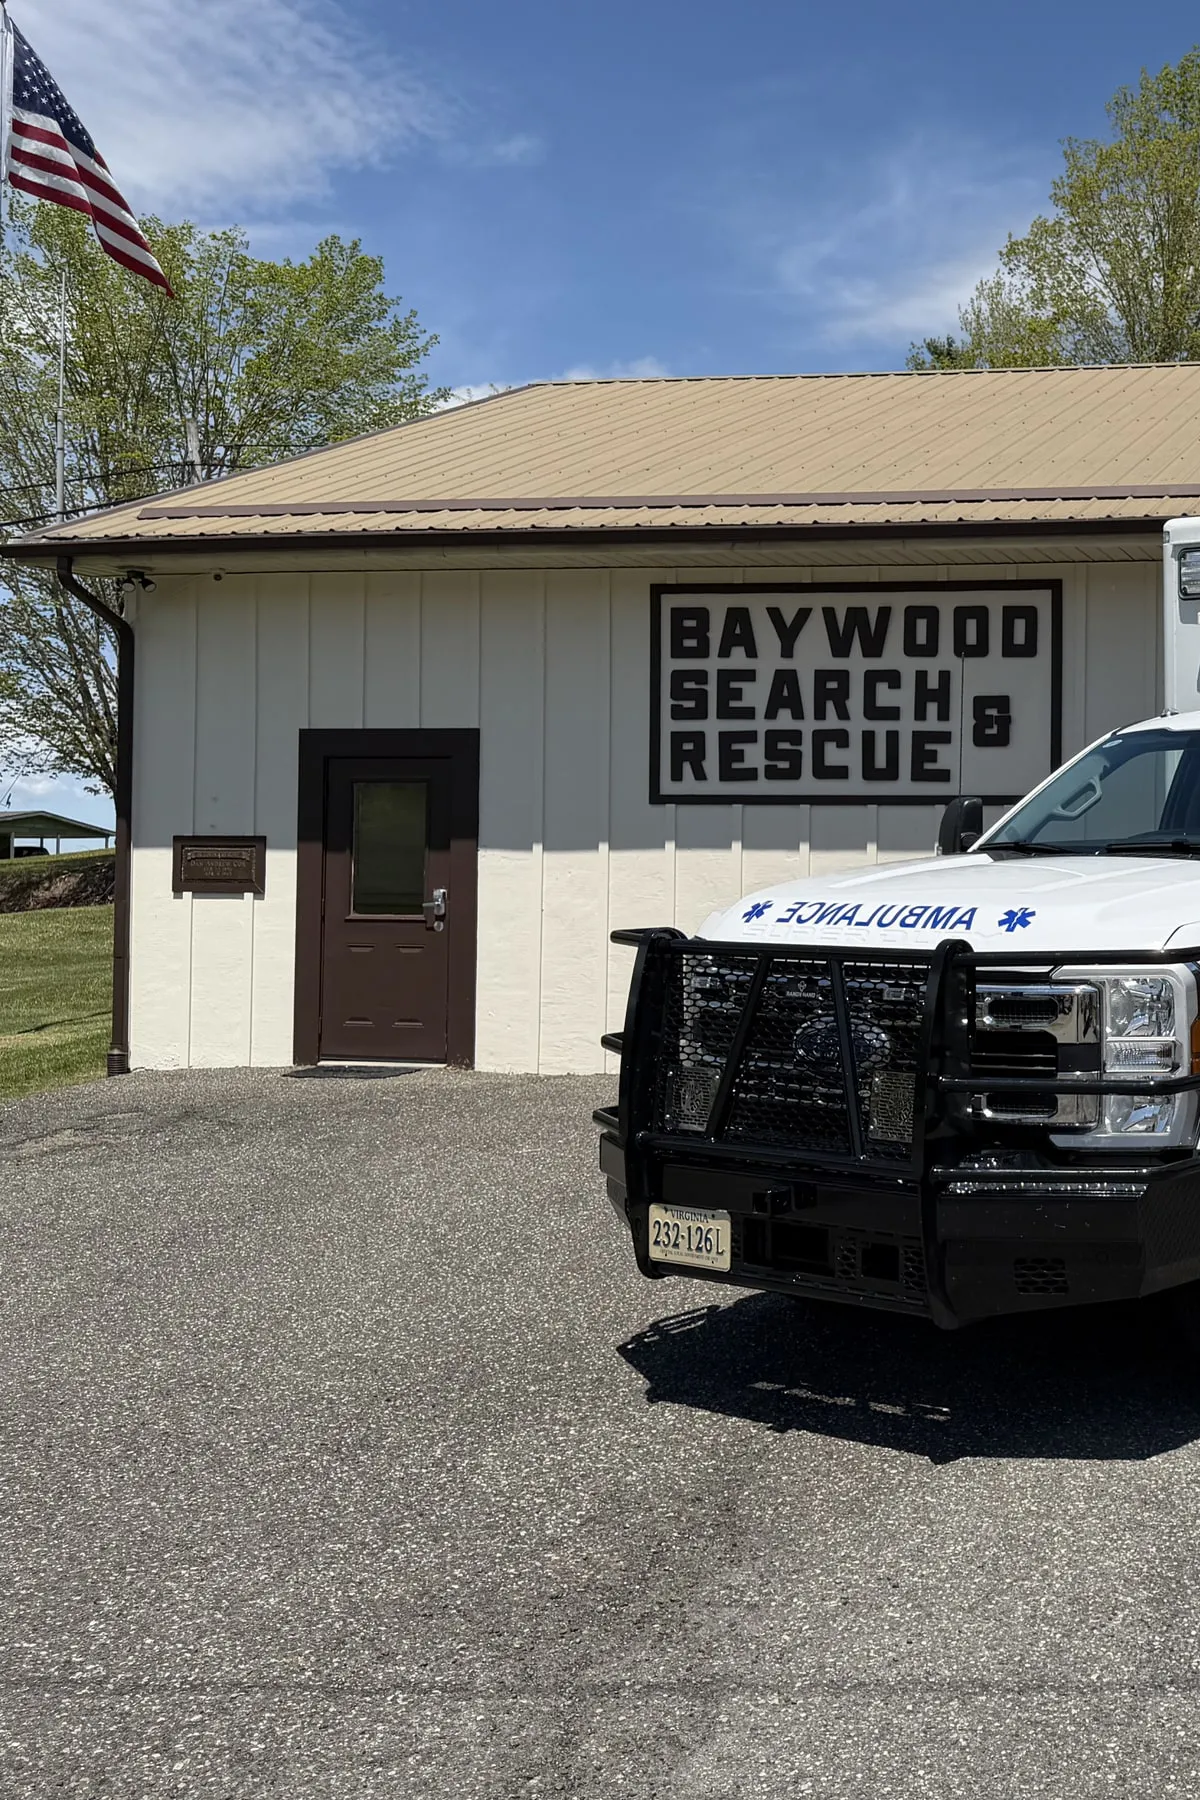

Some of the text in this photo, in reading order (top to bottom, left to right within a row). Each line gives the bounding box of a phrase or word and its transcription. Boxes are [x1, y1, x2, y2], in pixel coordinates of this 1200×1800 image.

[670, 605, 1038, 658] BAYWOOD
[670, 668, 1011, 747] SEARCH &
[670, 729, 952, 782] RESCUE
[653, 1219, 725, 1256] 232-126L
[670, 1208, 709, 1224] VIRGINIA
